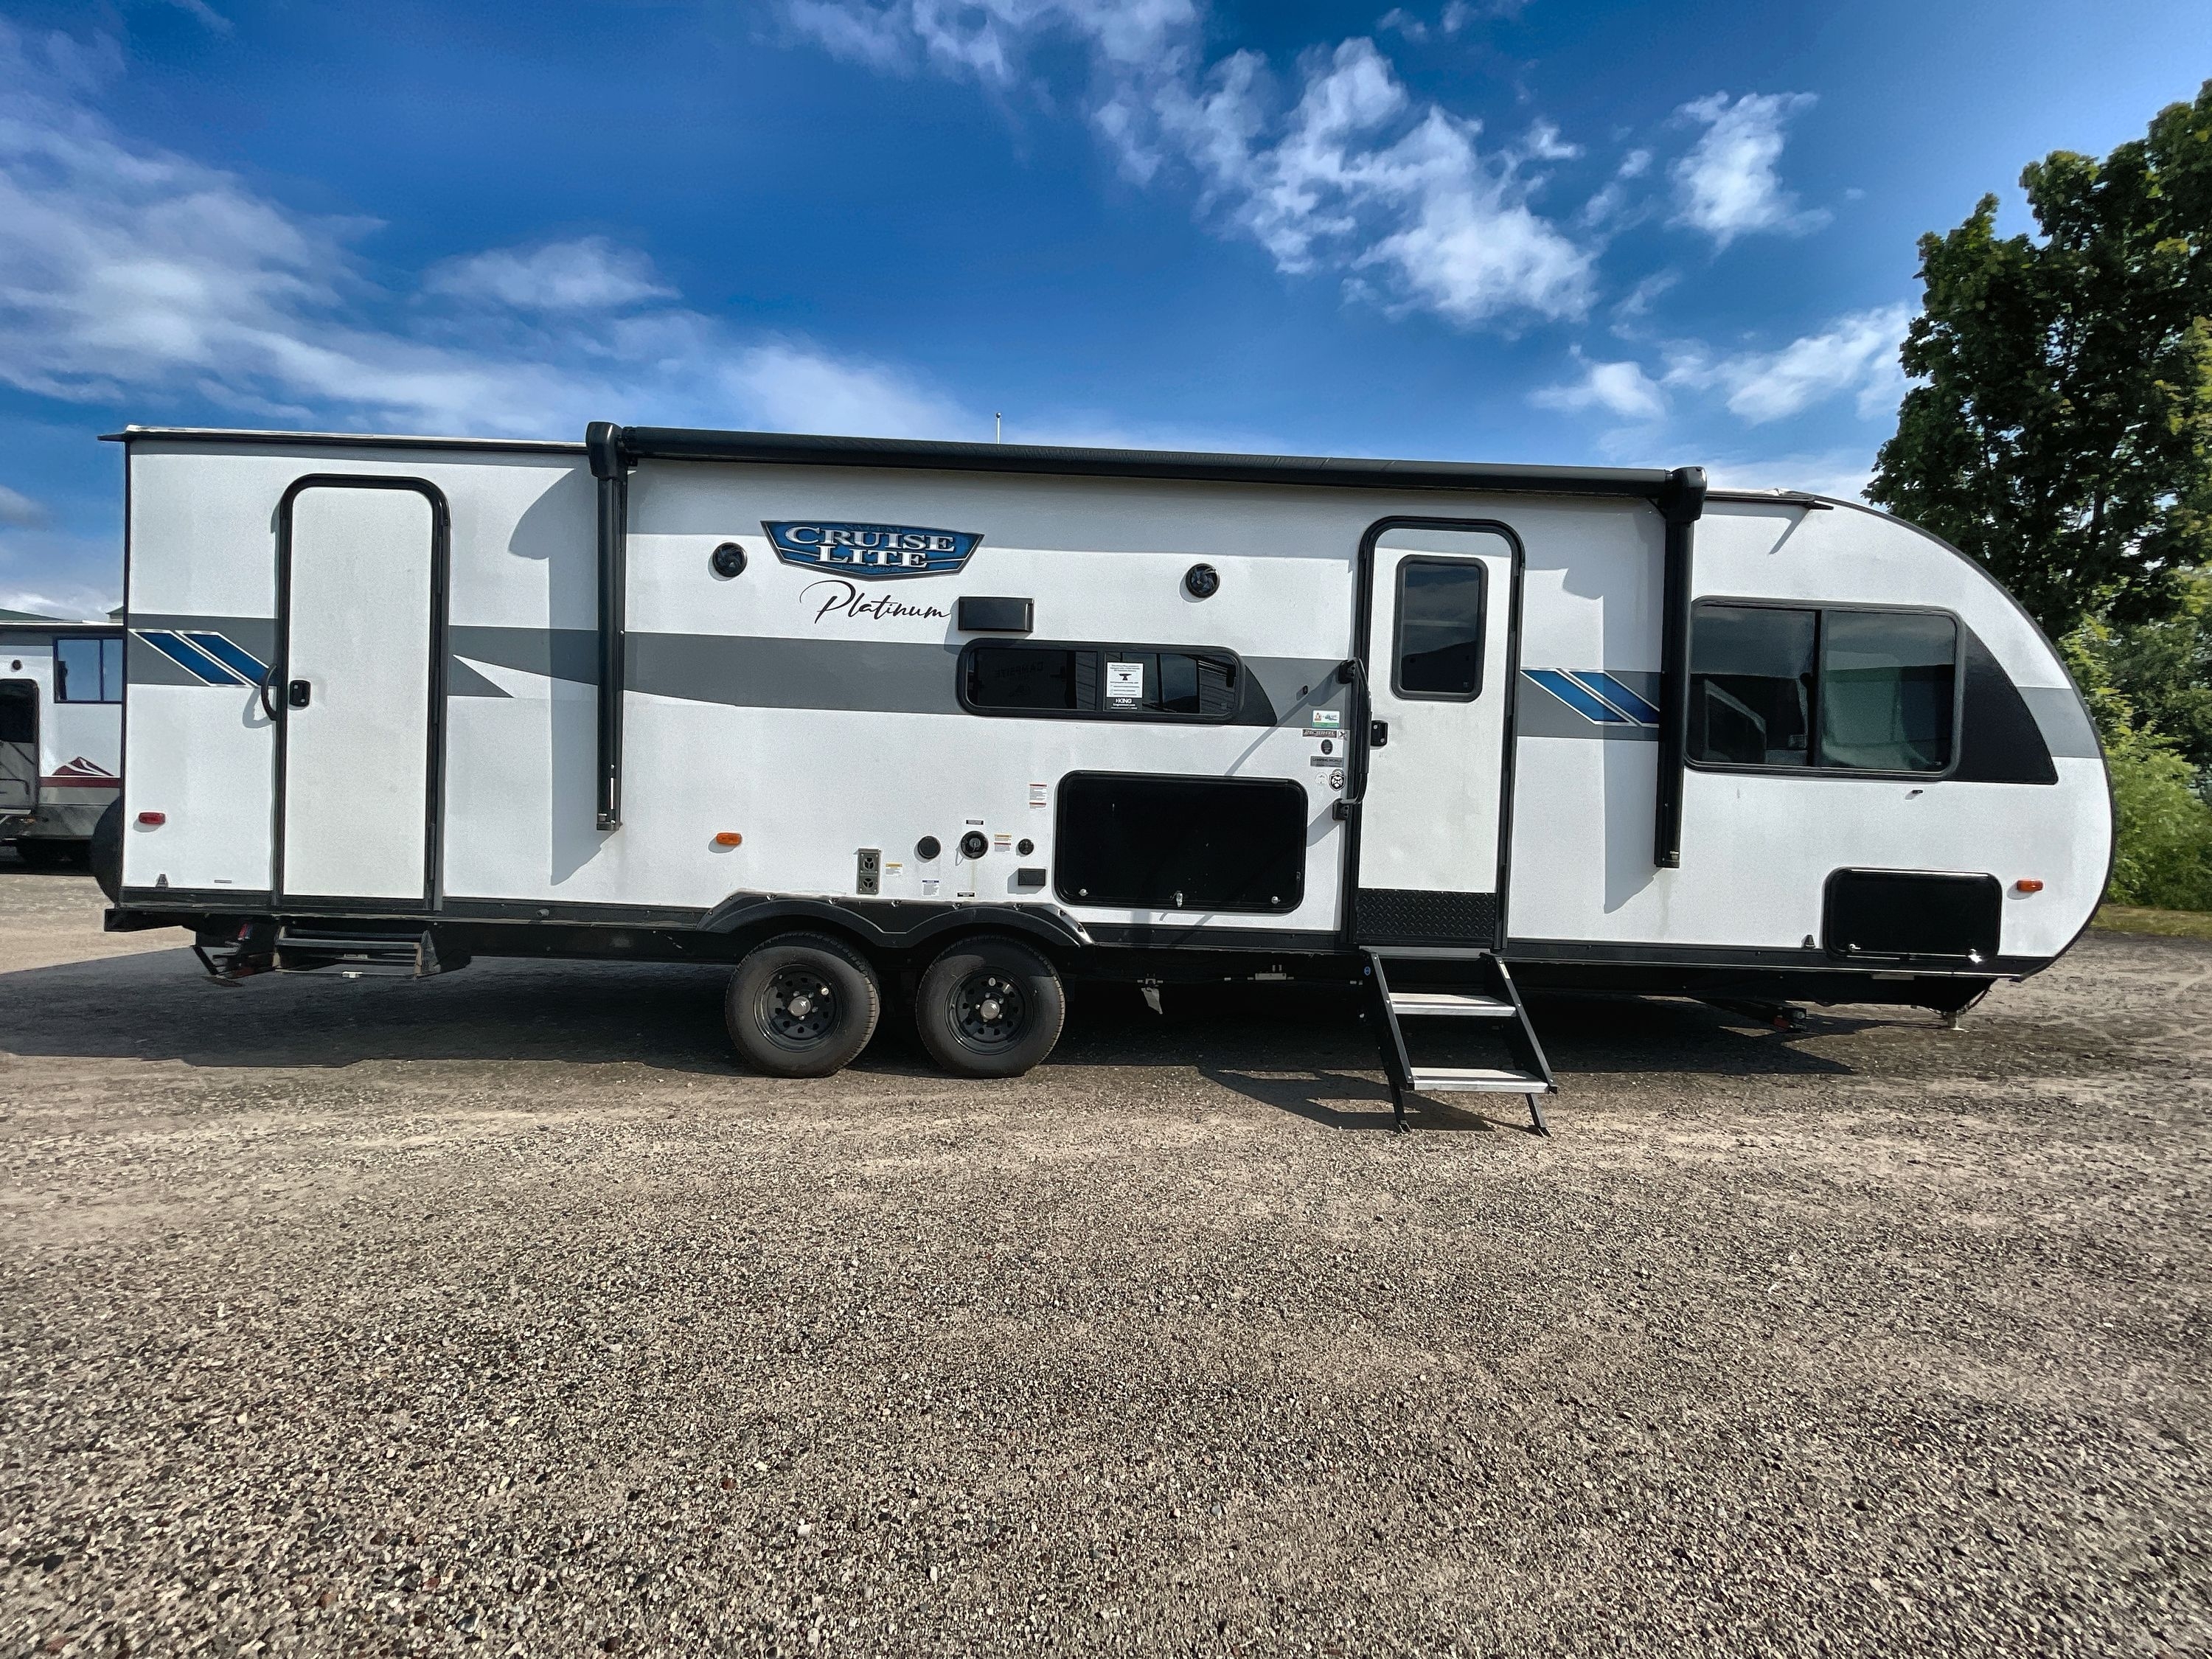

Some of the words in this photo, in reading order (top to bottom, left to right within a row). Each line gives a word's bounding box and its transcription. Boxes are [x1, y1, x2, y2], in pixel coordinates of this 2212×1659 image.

[785, 526, 955, 552] CRUISE
[815, 546, 928, 568] LITE
[799, 580, 951, 624] Platinum
